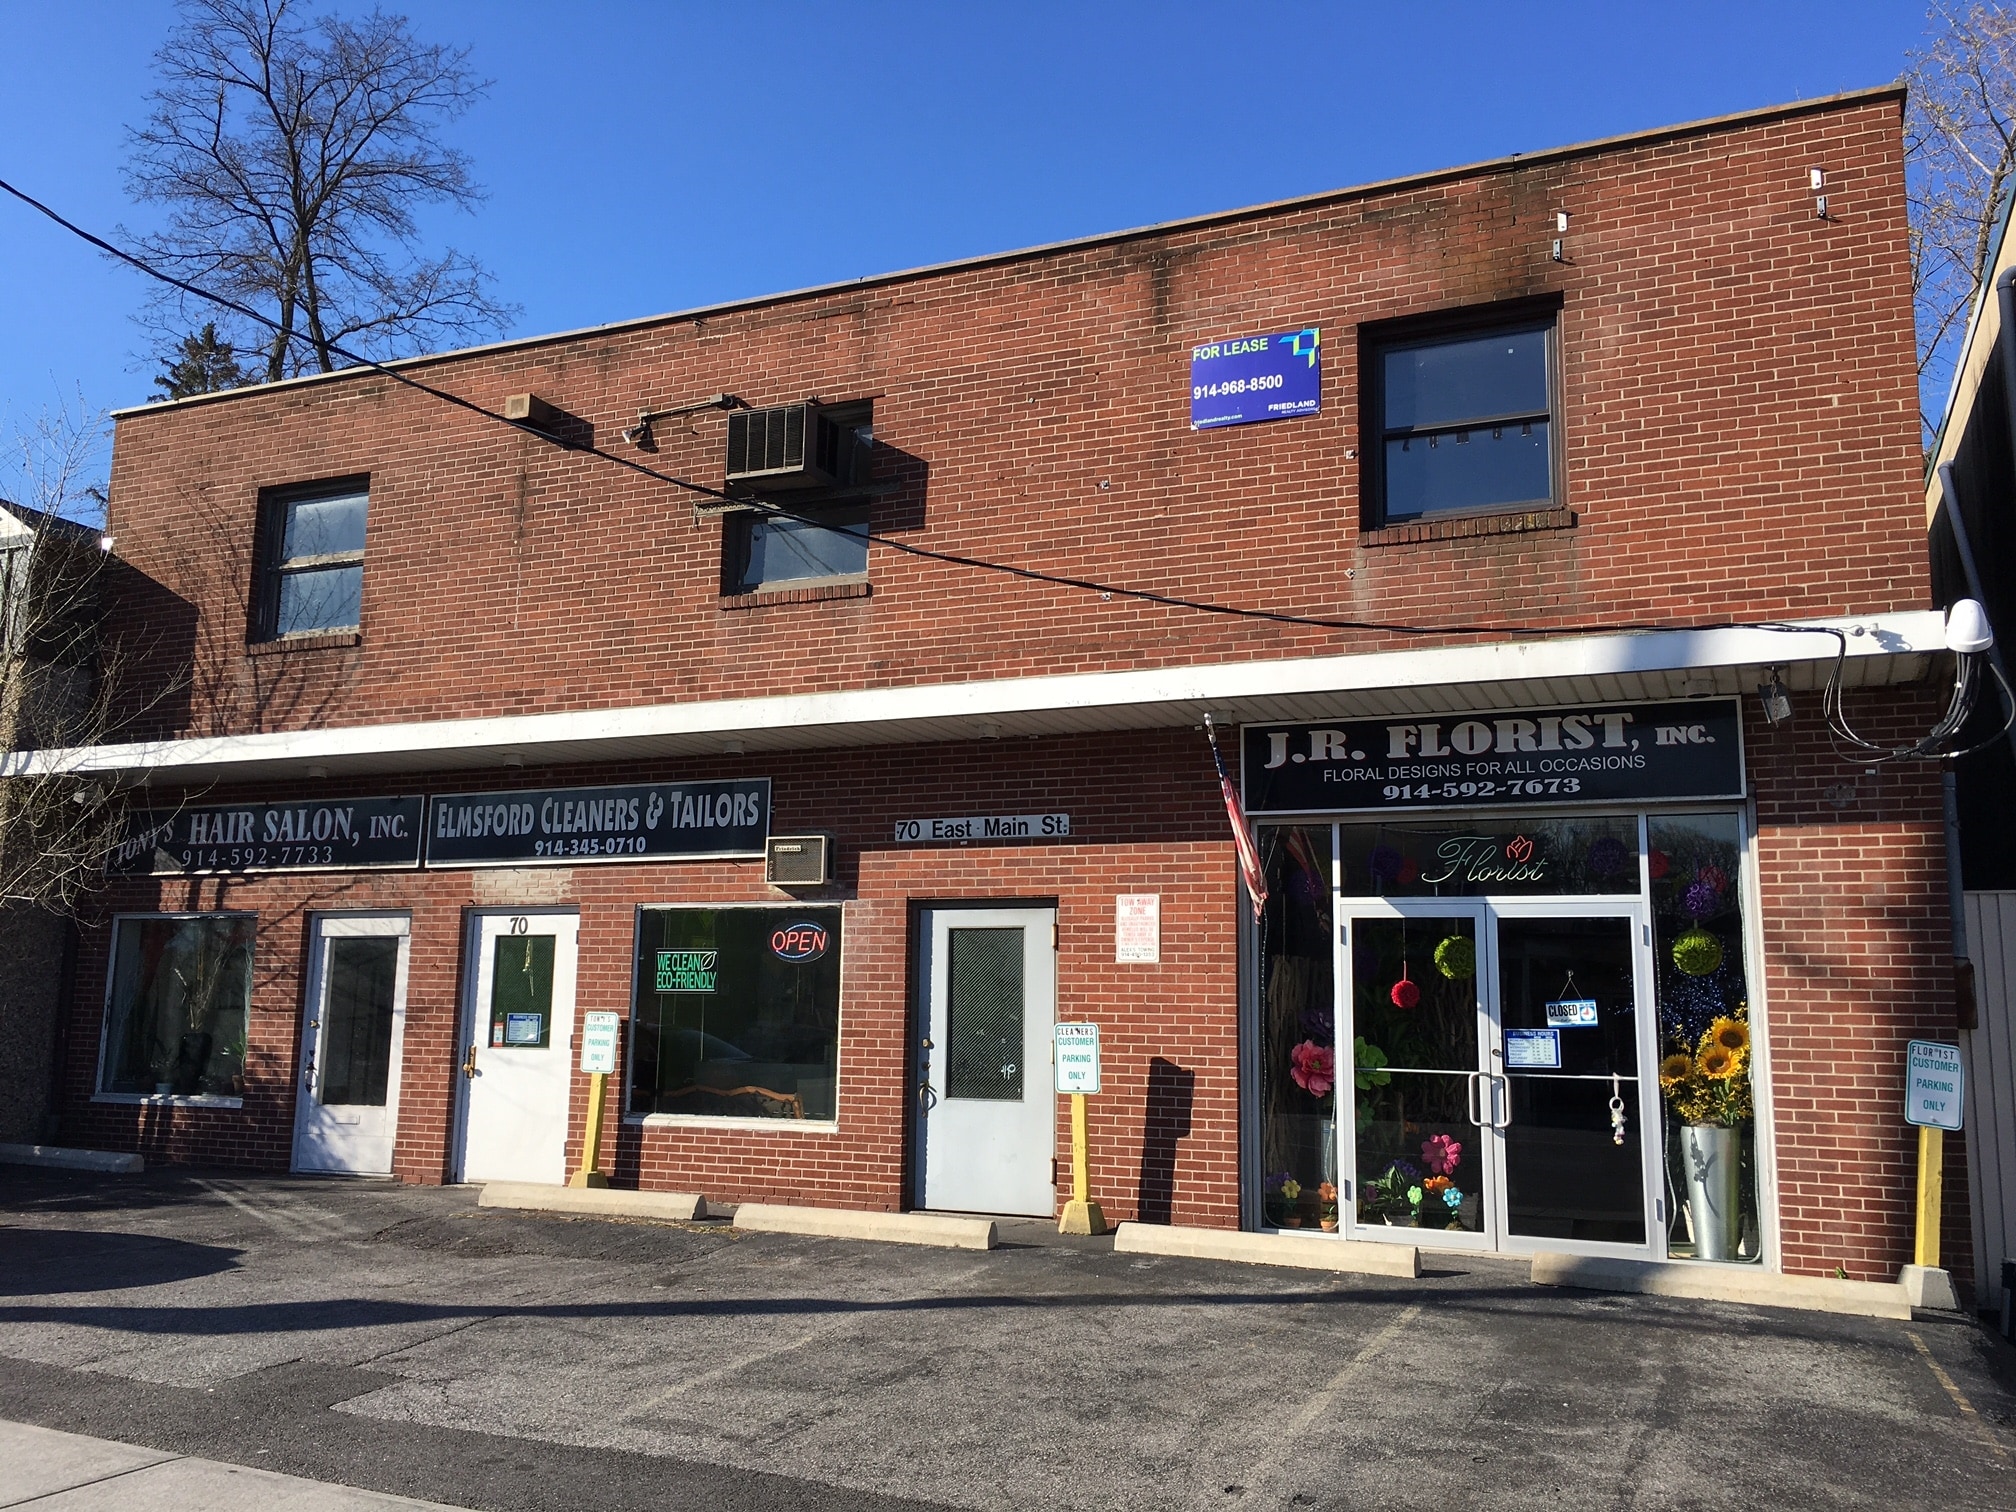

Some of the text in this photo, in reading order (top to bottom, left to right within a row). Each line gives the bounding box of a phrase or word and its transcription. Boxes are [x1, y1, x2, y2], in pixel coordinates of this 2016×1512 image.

[1193, 338, 1268, 362] FOR LEASE
[1193, 374, 1283, 400] 914-968-8500
[1268, 400, 1316, 411] FRIEDLAND
[1264, 712, 1716, 769] J.R. FLORIST, INC.
[1323, 754, 1647, 783] FLORAL DESIGNS FOR ALL OCCASIONS
[1382, 777, 1582, 800] 914-592-7673
[436, 790, 760, 838] ELMSFORD CLEANERS & TAILORS
[188, 811, 255, 845] HAIR
[262, 807, 359, 847] SALON,
[368, 814, 409, 839] INC.
[897, 820, 921, 840] 70
[931, 818, 973, 840] East
[983, 816, 1032, 838] Main
[535, 836, 646, 857] 914-345-0710
[182, 846, 333, 867] 914-592-7733
[1421, 835, 1548, 883] Florist
[1121, 898, 1155, 907] TOW AWAY
[1129, 906, 1146, 915] ZONE
[509, 916, 528, 935] 70
[771, 930, 826, 951] OPEN
[657, 952, 701, 971] WE CLEAN
[656, 970, 717, 989] ECO-FRIENDLY
[1548, 1004, 1578, 1017] CLOSED
[587, 1024, 613, 1032] CUSTOMER
[1057, 1027, 1094, 1036] CLEANERS
[588, 1038, 610, 1047] PARKING
[1058, 1037, 1095, 1046] CUSTOMER
[591, 1053, 605, 1061] ONLY
[1062, 1054, 1091, 1063] PARKING
[1912, 1046, 1954, 1059] FLORIST
[1912, 1057, 1958, 1072] CUSTOMER
[1068, 1071, 1086, 1080] ONLY
[1916, 1078, 1954, 1093] PARKING
[1923, 1099, 1946, 1112] ONLY
